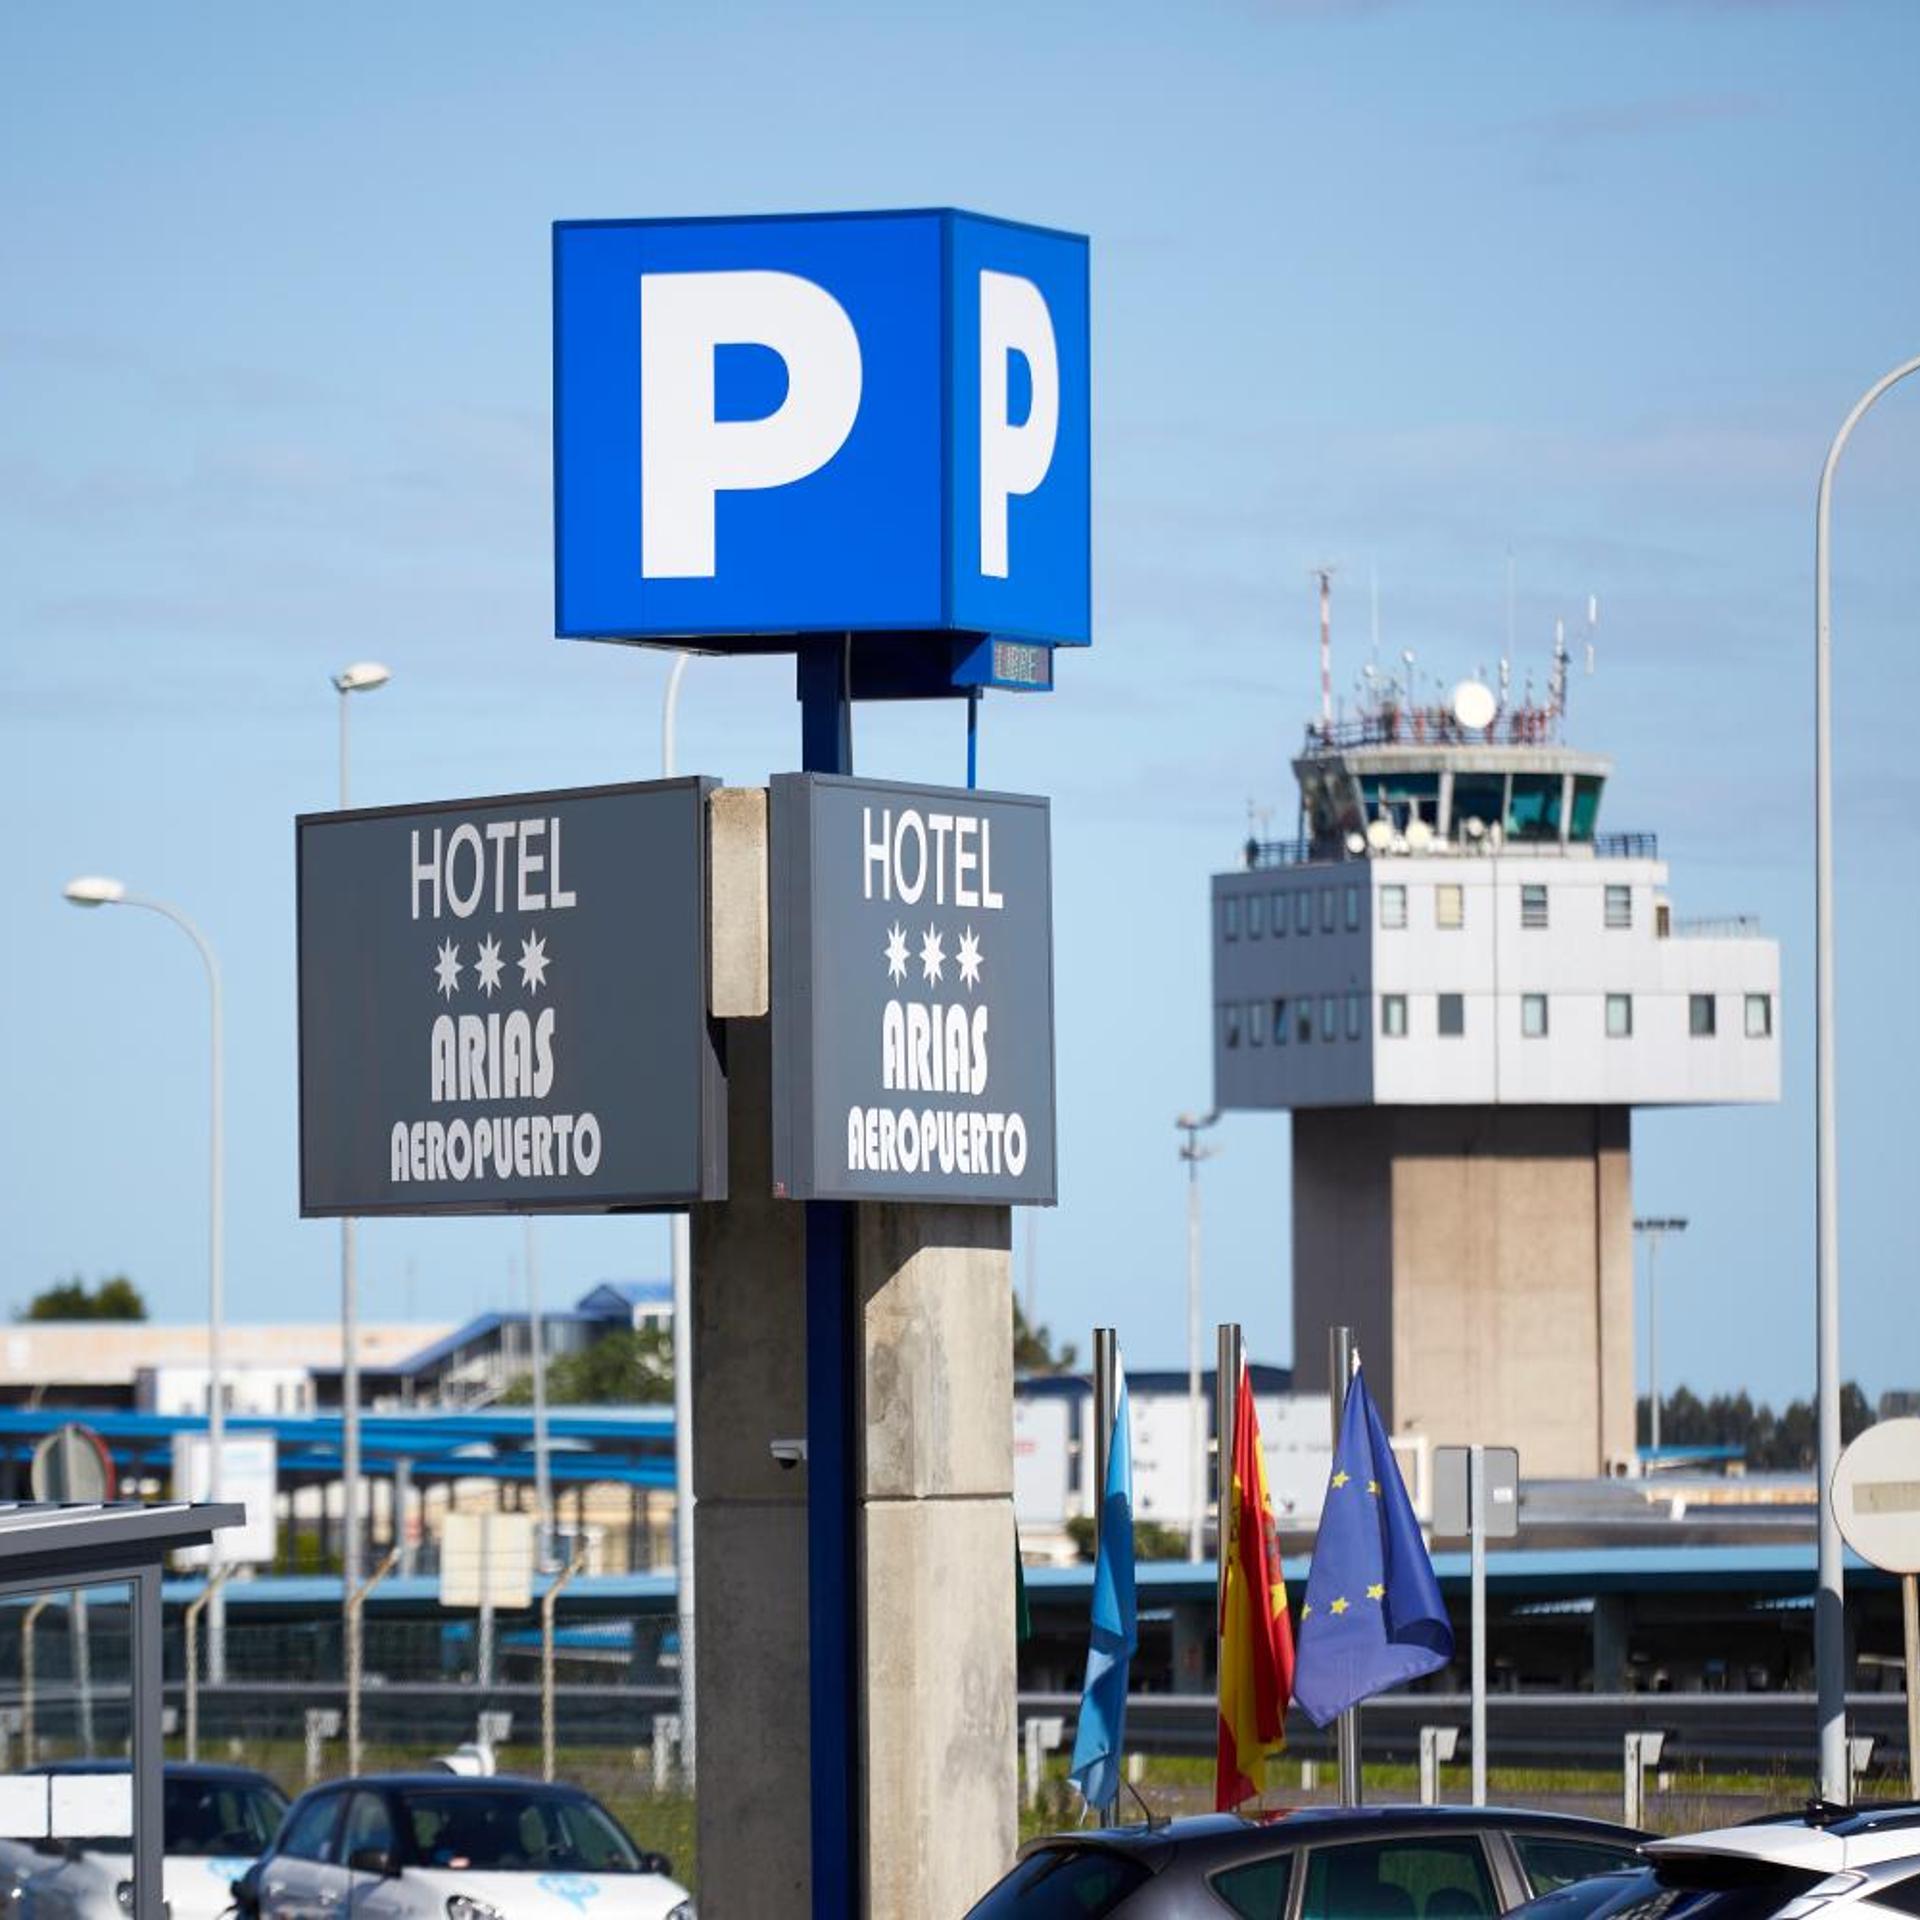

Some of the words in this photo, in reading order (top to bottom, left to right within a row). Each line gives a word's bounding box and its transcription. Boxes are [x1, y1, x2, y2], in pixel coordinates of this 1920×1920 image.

[641, 271, 862, 578] P
[981, 271, 1058, 579] P
[411, 817, 577, 920] HOTEL
[863, 808, 1004, 910] HOTEL
[431, 1007, 555, 1102] ARIAS
[882, 1000, 988, 1096] ARIAS
[391, 1112, 602, 1182] AEROPUERTO
[848, 1106, 1028, 1177] AEROPUERTO
